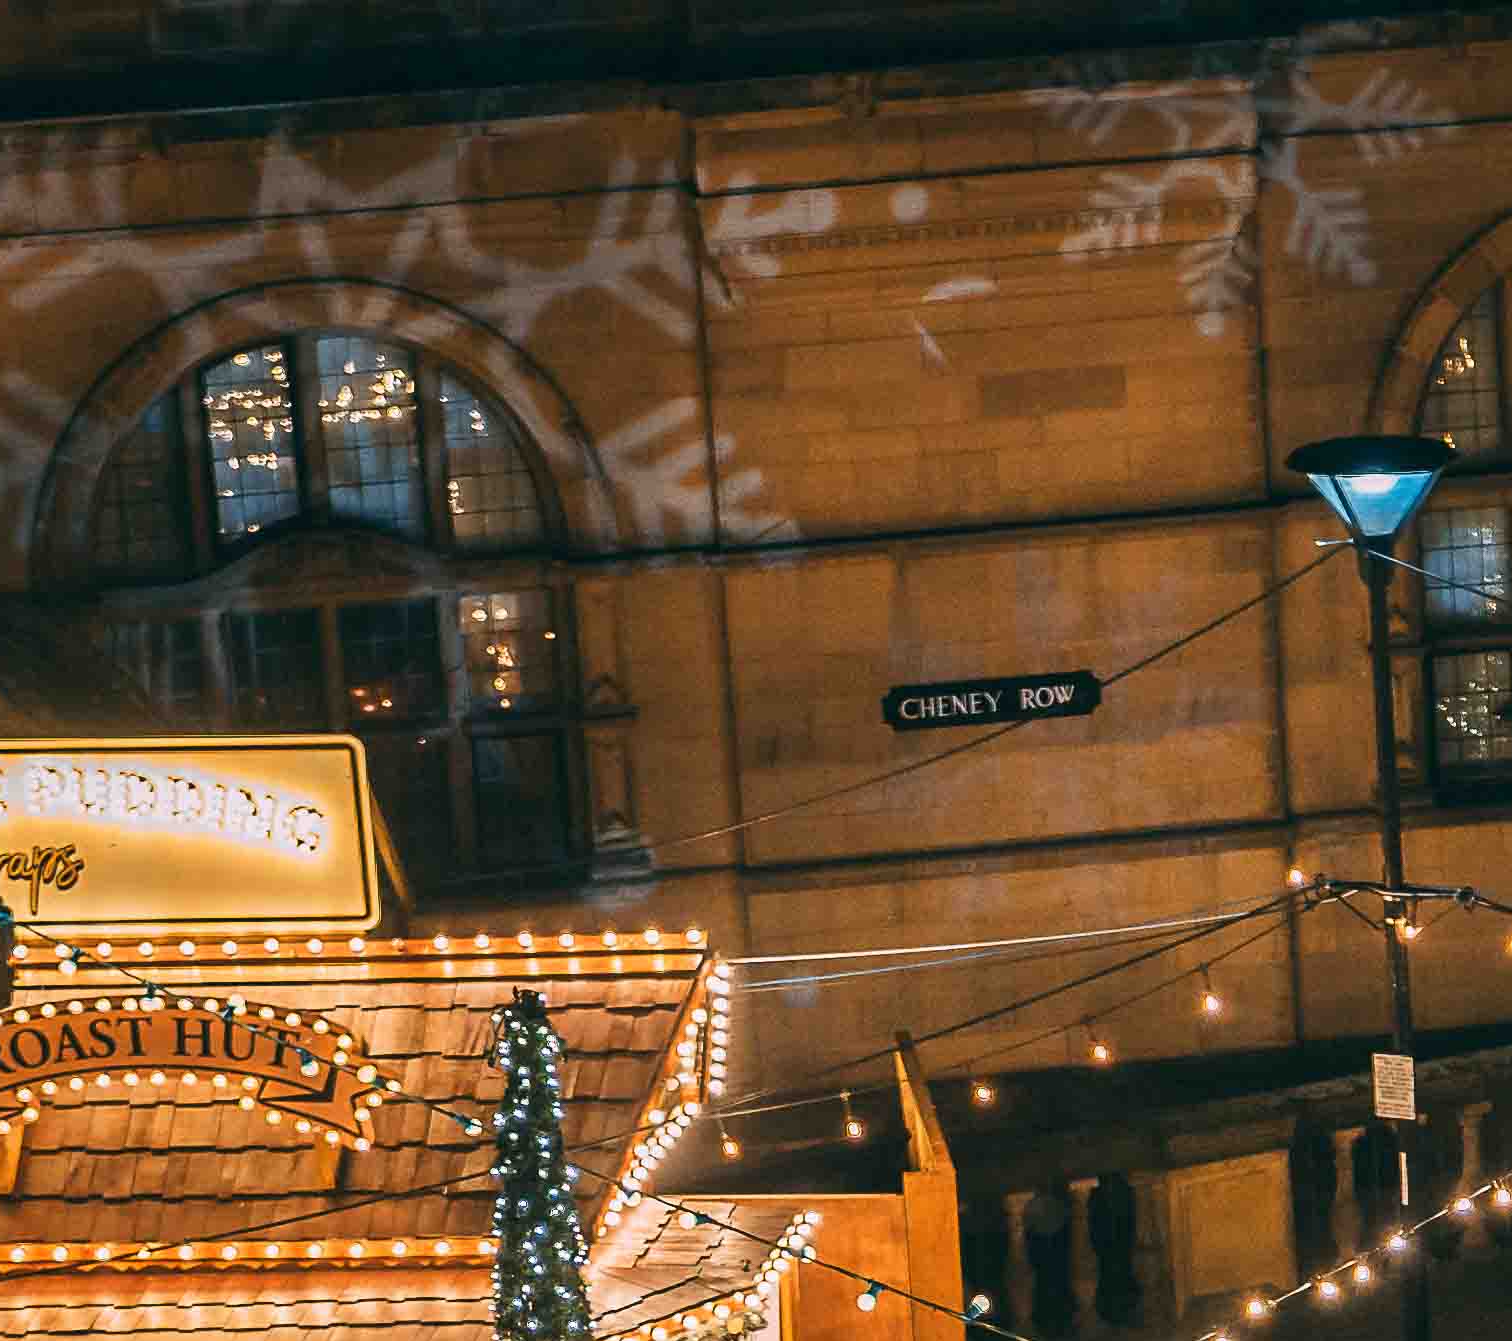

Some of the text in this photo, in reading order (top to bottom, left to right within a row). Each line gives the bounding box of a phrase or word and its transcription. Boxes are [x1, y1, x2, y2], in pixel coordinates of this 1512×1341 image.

[898, 684, 1076, 720] CHENEY ROW
[24, 765, 327, 856] PUDDING
[175, 1015, 305, 1073] HUT
